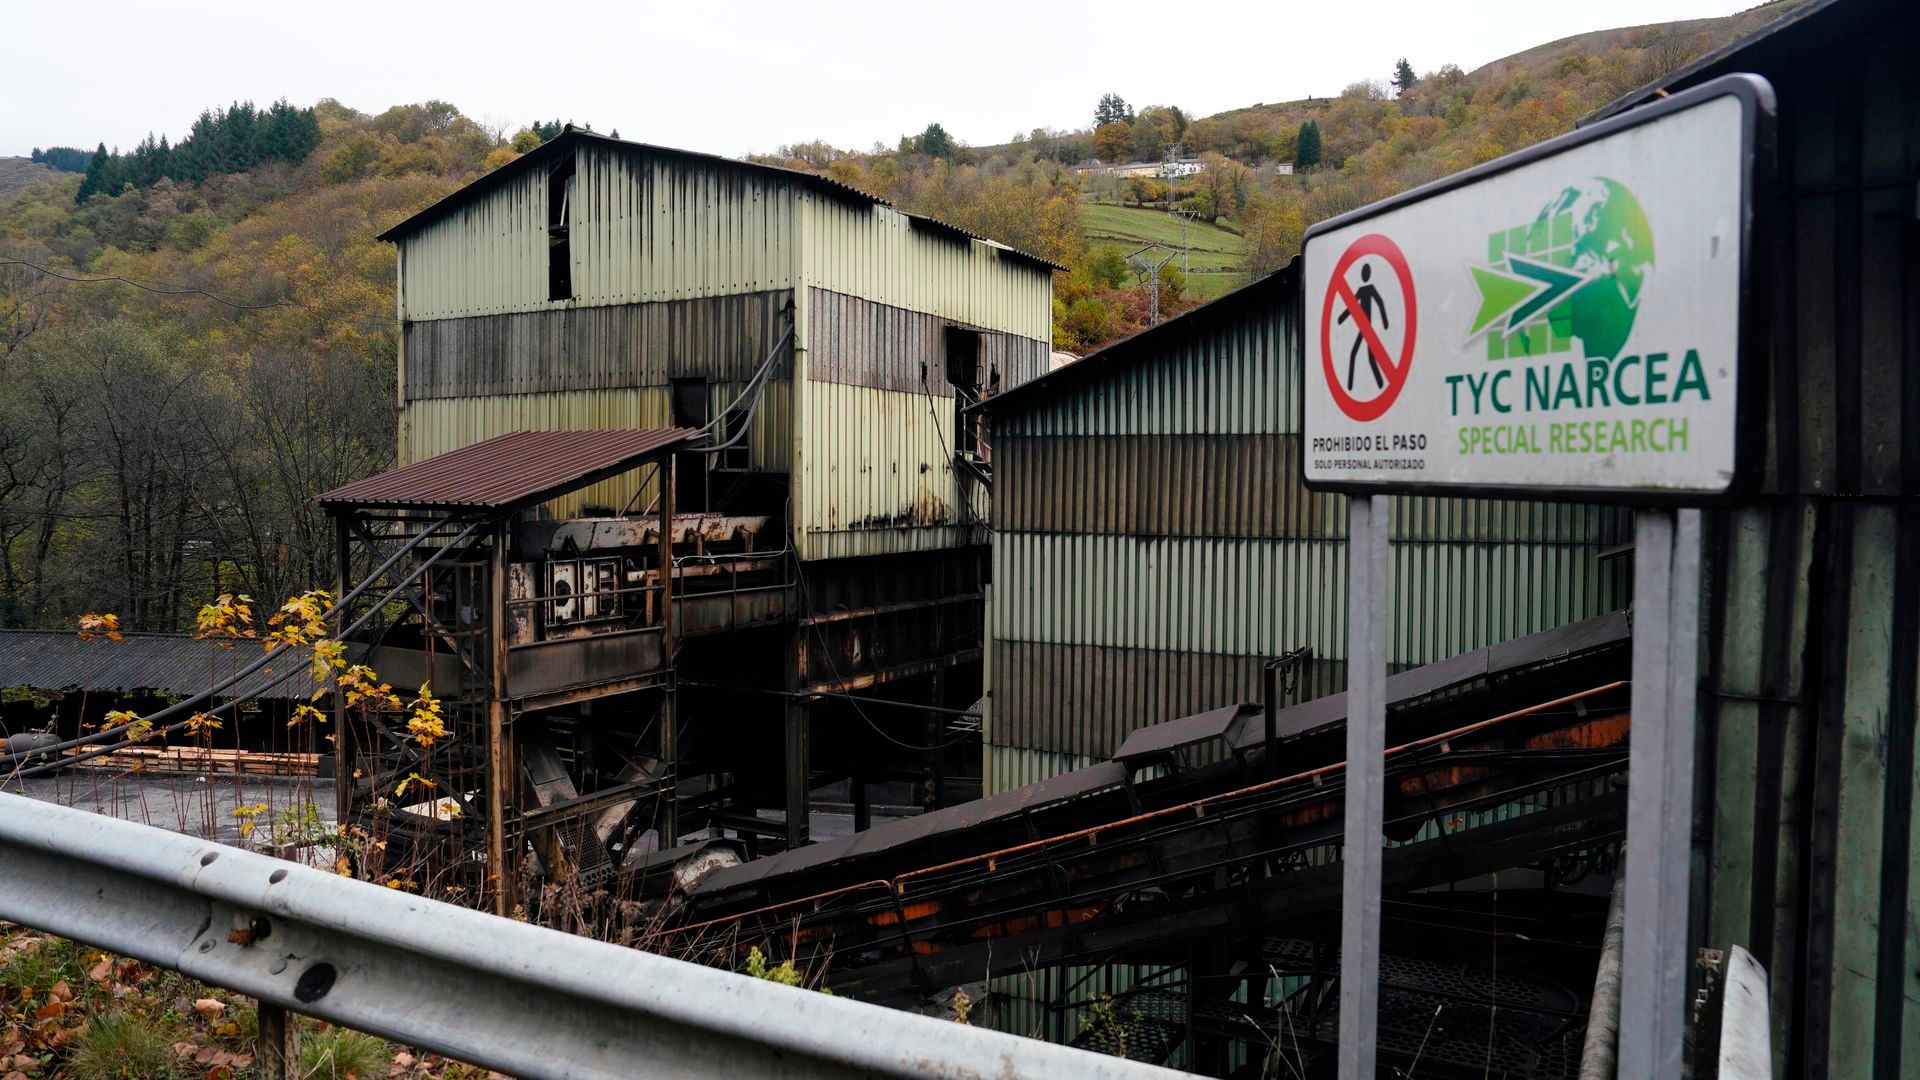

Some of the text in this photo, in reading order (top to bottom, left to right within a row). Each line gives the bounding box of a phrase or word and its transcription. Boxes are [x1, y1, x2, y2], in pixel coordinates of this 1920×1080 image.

[1445, 349, 1711, 416] TYC NARCEA
[1313, 434, 1427, 452] PROHIBIDO EL PASO
[1458, 418, 1689, 455] SPECIAL RESEARCH
[1314, 459, 1425, 470] SOLO PERSONAL AUTORIZADO
